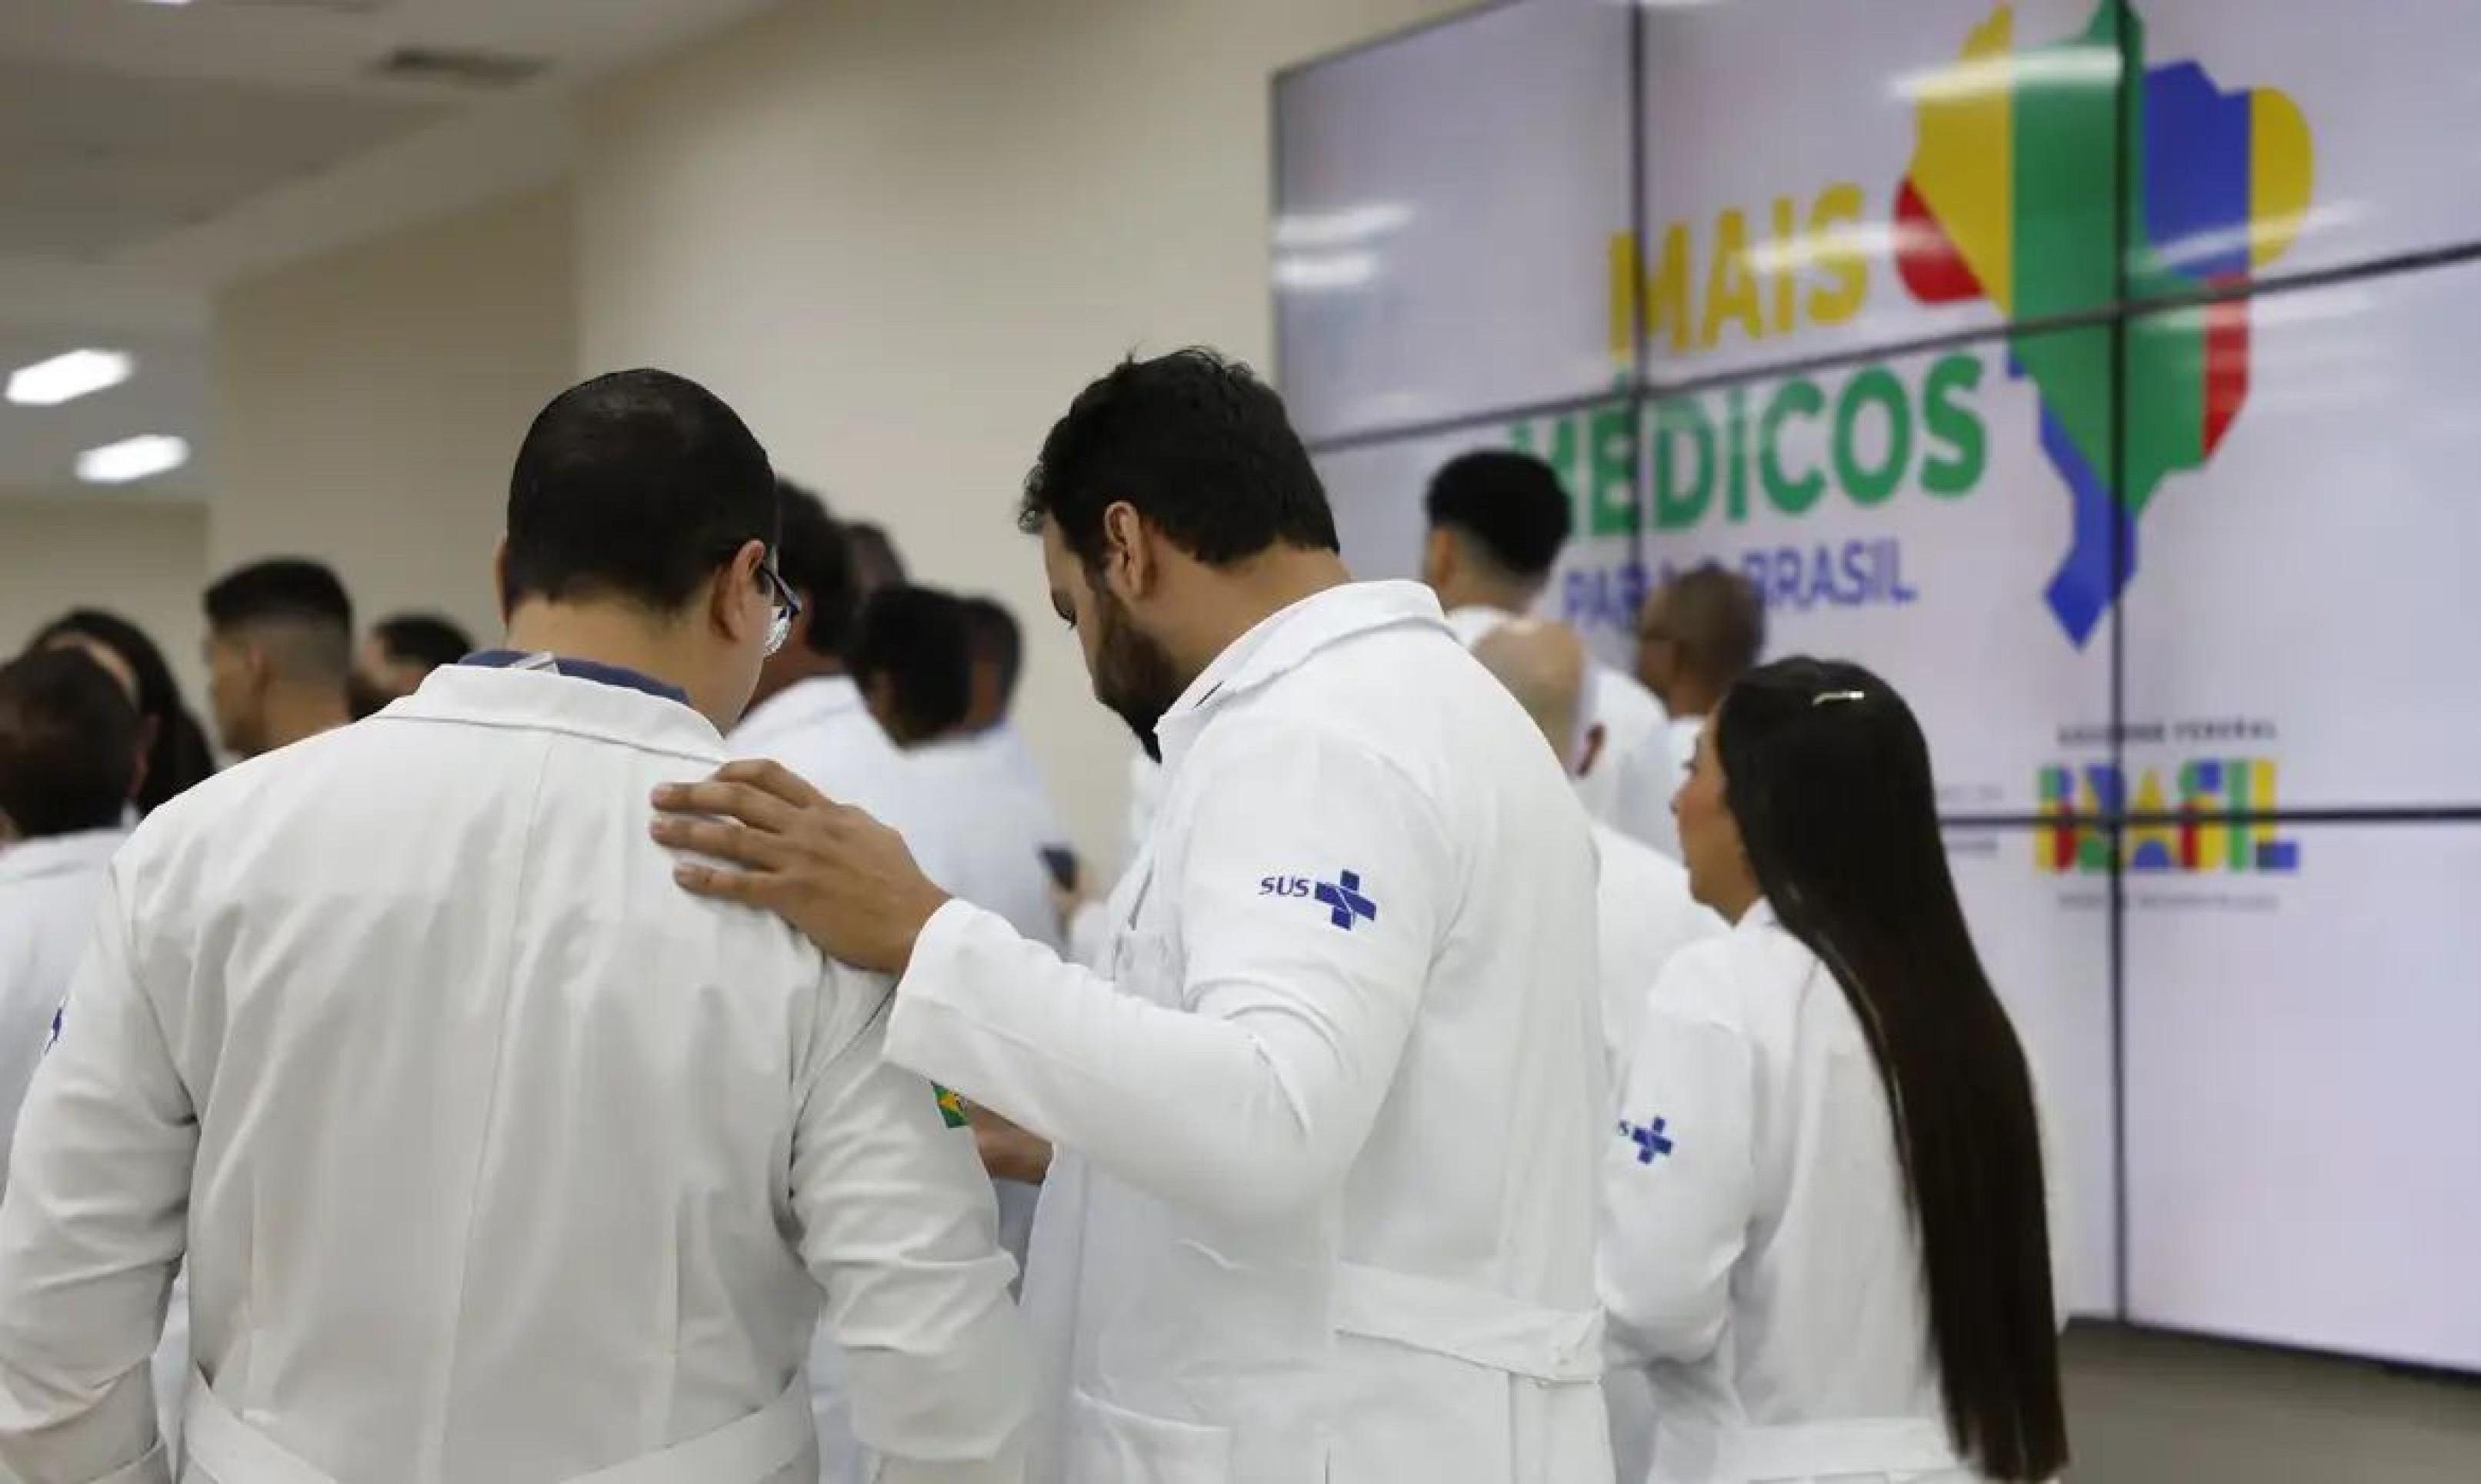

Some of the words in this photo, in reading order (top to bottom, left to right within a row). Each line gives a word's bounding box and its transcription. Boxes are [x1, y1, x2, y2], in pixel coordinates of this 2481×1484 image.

[1606, 182, 1869, 363] MAIS
[1564, 555, 1679, 629] PAR
[2034, 757, 2299, 875] BRASIL
[1257, 875, 1310, 898] SUS
